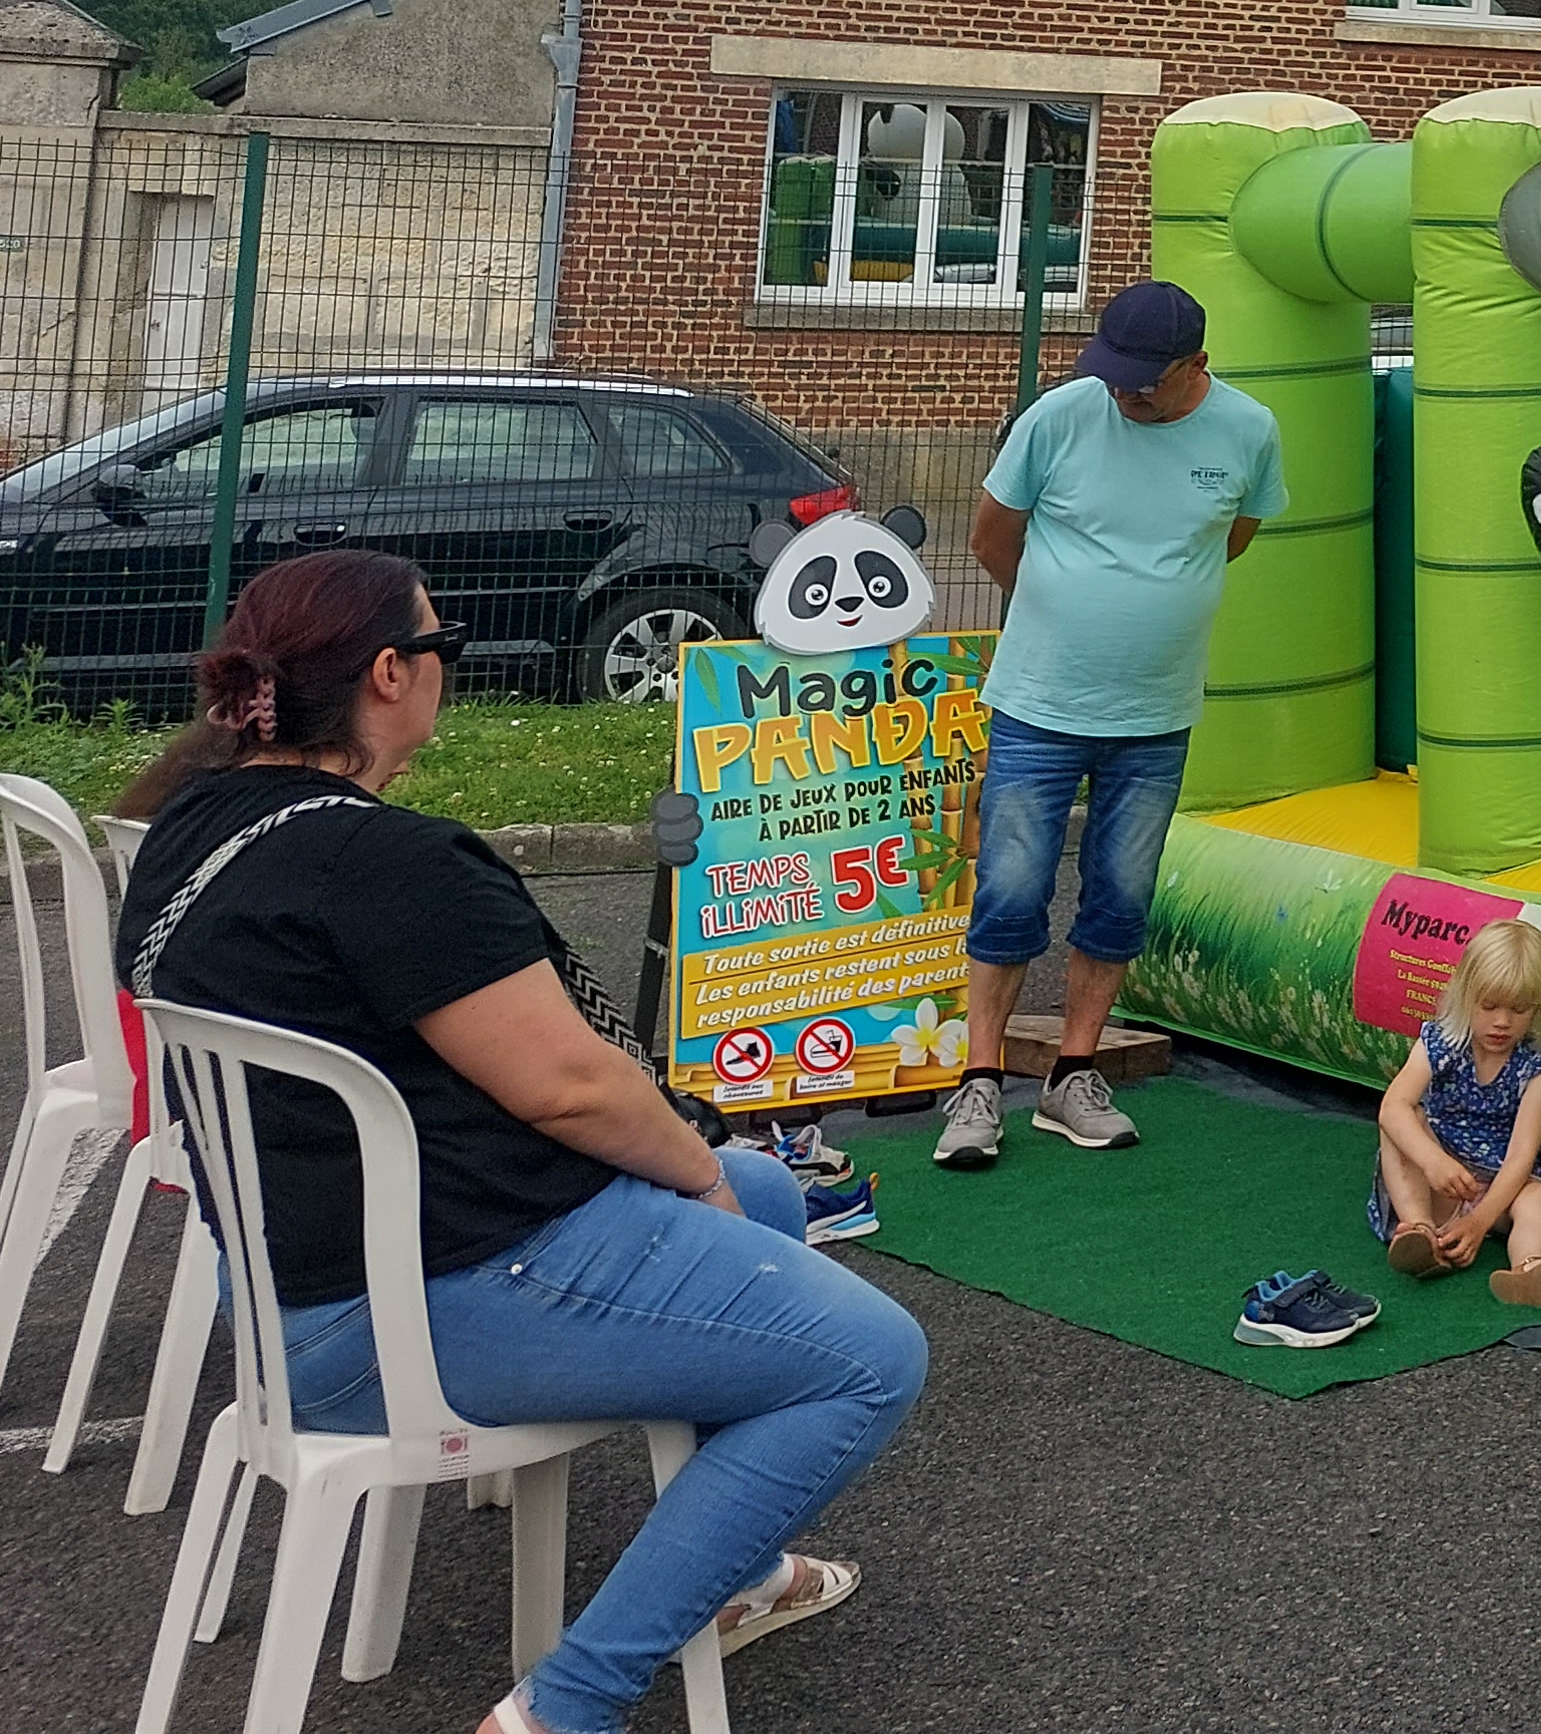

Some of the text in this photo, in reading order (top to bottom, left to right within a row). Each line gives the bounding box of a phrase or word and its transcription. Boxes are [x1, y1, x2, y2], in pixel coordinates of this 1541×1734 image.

[737, 658, 938, 718] Magic
[693, 689, 992, 793] PANDA
[711, 758, 976, 822] AIRE DE JEUX POUR ENFANTS
[759, 793, 936, 842] À PARTIR DE 2 ANS
[706, 852, 811, 897] TEMPS
[831, 835, 909, 913] 5€
[696, 984, 733, 1005] Les
[738, 966, 820, 997] enfants
[824, 952, 902, 980] restent
[904, 942, 949, 965] sous
[704, 914, 971, 975] Toute sortie est définitive
[696, 962, 970, 1029] responsabilité des parent
